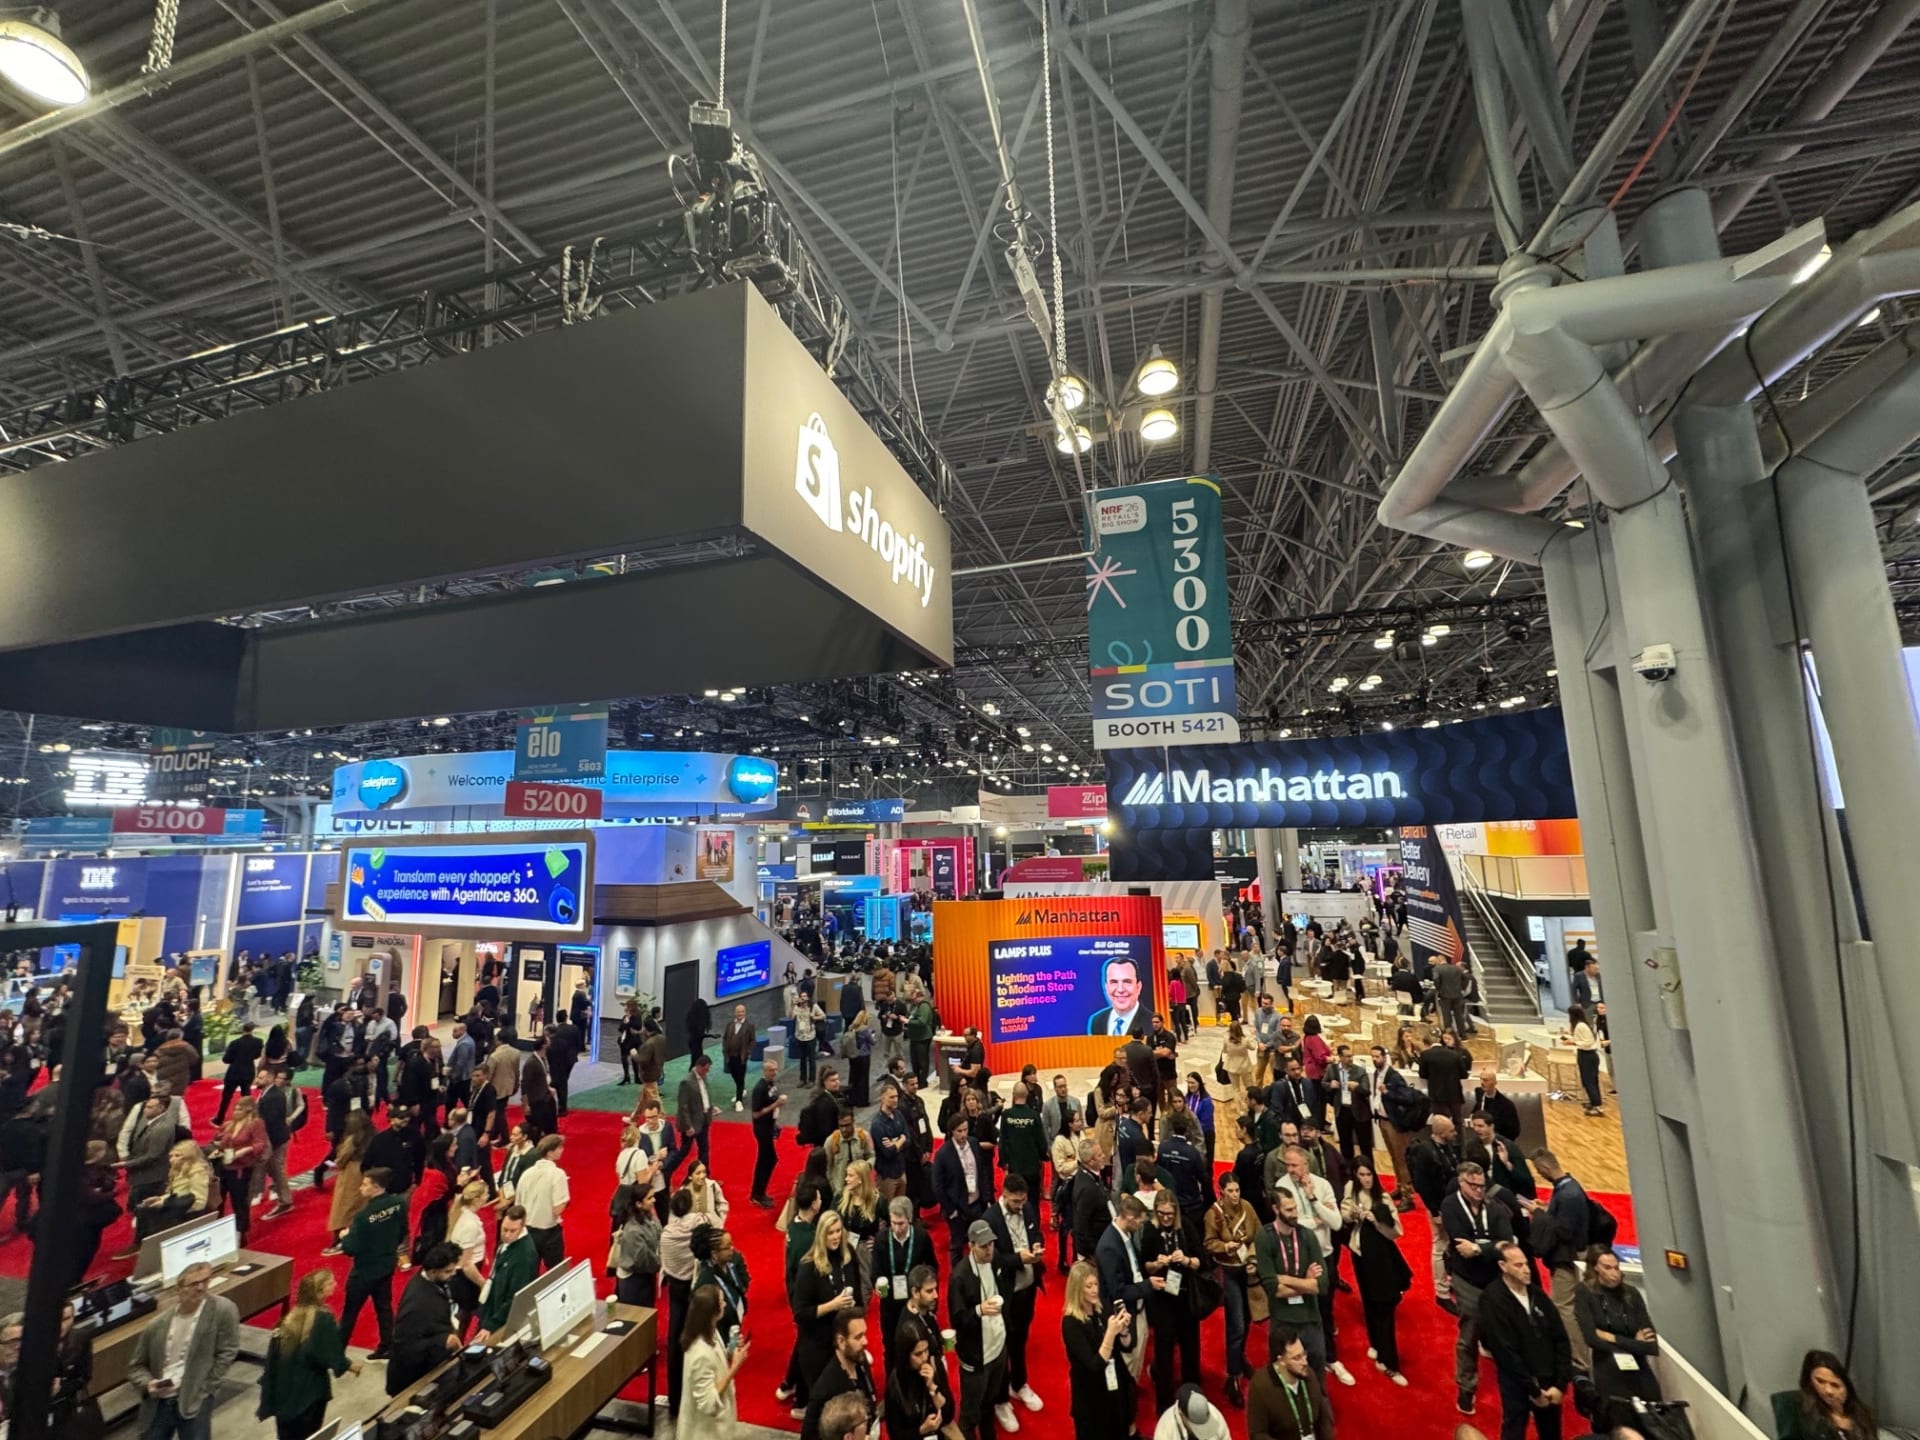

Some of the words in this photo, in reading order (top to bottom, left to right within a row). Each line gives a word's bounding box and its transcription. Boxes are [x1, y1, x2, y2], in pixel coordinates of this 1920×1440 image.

[1101, 504, 1123, 515] NRF
[1101, 512, 1139, 521] RETAIL'S
[1116, 519, 1139, 527] SHOW
[847, 485, 935, 608] shopify
[1170, 498, 1210, 652] 5300
[1104, 676, 1220, 711] SOTI
[1108, 720, 1175, 737] BOOTH
[1181, 717, 1225, 734] 5421
[153, 751, 210, 773] TOUCH
[578, 762, 601, 772] 5803
[362, 775, 397, 790] salesforce
[448, 774, 505, 787] Welcome
[612, 772, 680, 787] Enterprise
[523, 788, 588, 815] 5200
[137, 809, 206, 829] 5100
[1446, 827, 1477, 840] Retail
[80, 866, 116, 889] IBM
[393, 869, 437, 884] Transform
[438, 871, 466, 887] every
[468, 868, 521, 886] shopper's
[1403, 860, 1430, 887] Delivery
[376, 887, 429, 902] experience
[430, 886, 450, 901] with
[452, 886, 511, 905] Agentforce
[513, 887, 540, 904] 360.
[1034, 907, 1121, 924] Manhattan
[994, 946, 1027, 960] LAMPS
[1028, 945, 1052, 957] PLUS
[996, 973, 1035, 986] Lighting
[1036, 971, 1053, 981] the
[1054, 970, 1077, 980] Path
[997, 986, 1008, 996] to
[1008, 983, 1046, 995] Modern
[1047, 982, 1074, 992] Store
[997, 994, 1057, 1008] Experiences
